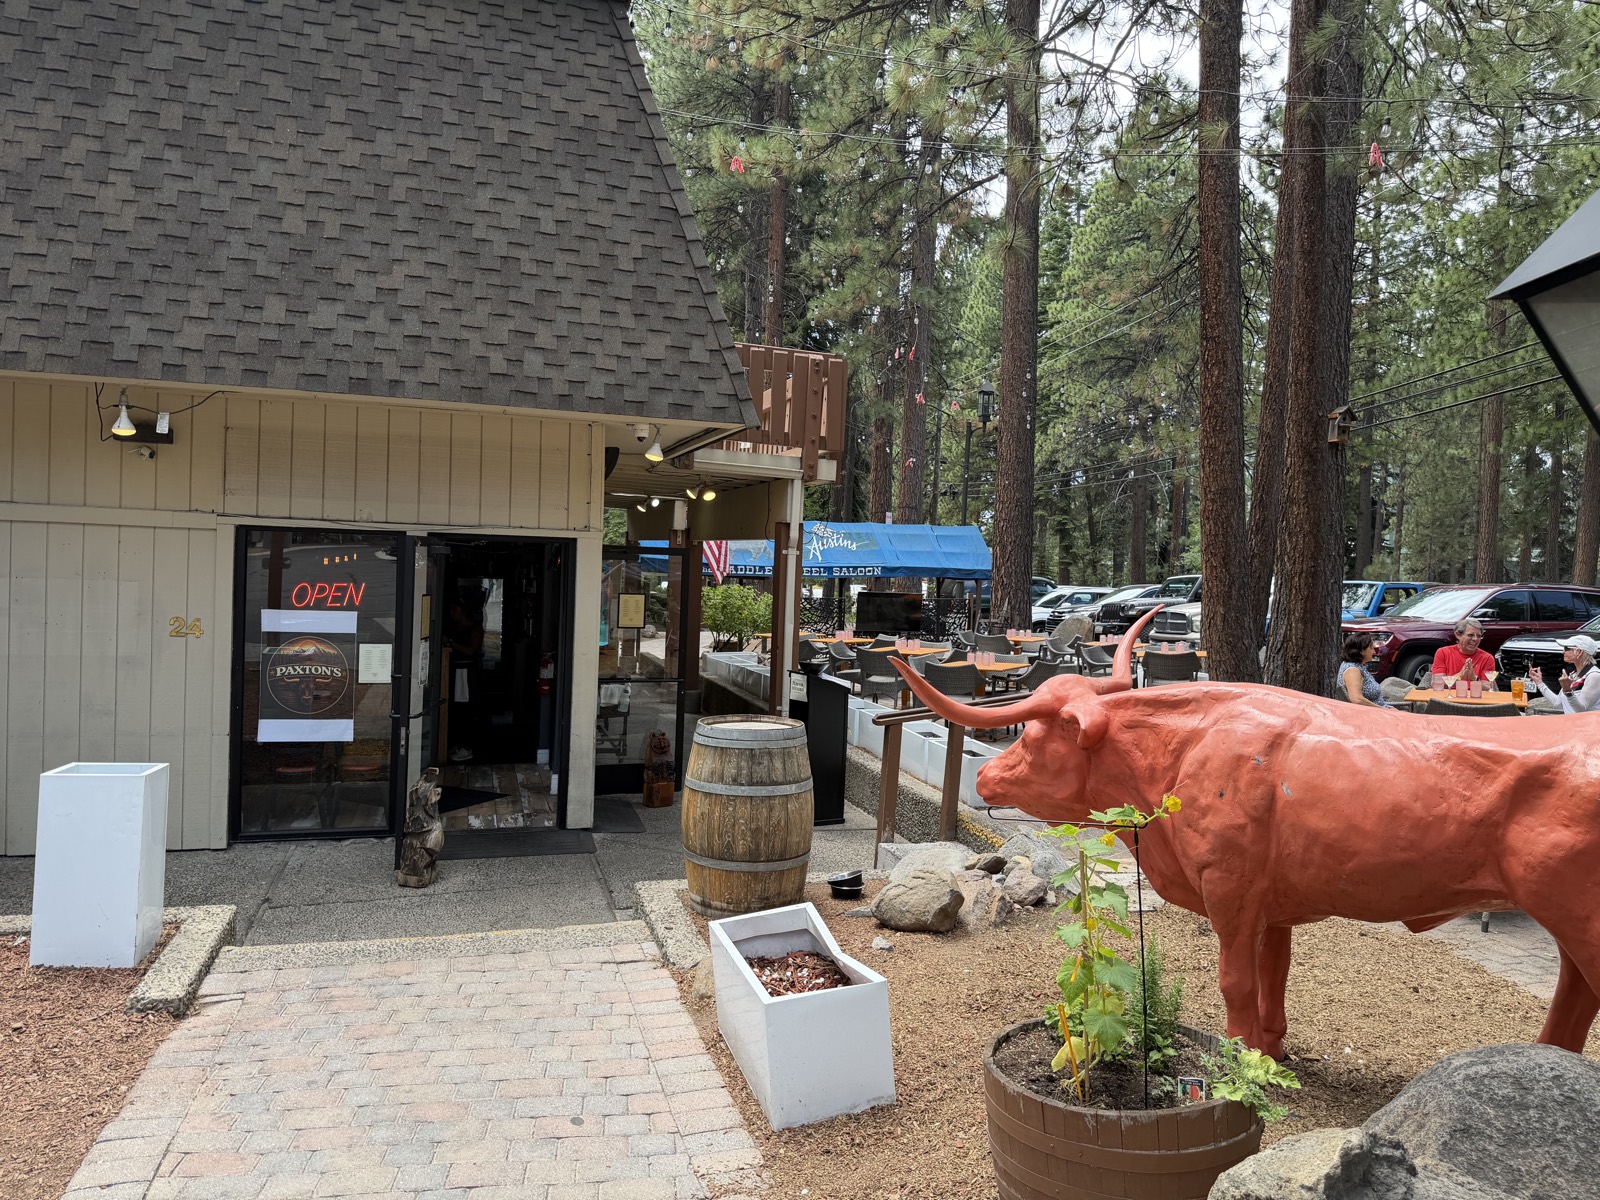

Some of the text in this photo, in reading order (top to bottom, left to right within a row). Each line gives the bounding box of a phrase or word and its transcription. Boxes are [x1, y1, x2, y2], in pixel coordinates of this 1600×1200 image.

[730, 566, 773, 575] ADDLE
[833, 567, 882, 576] SALOON
[292, 582, 366, 607] OPEN
[169, 616, 205, 638] 24
[275, 665, 342, 677] PAXTON'S
